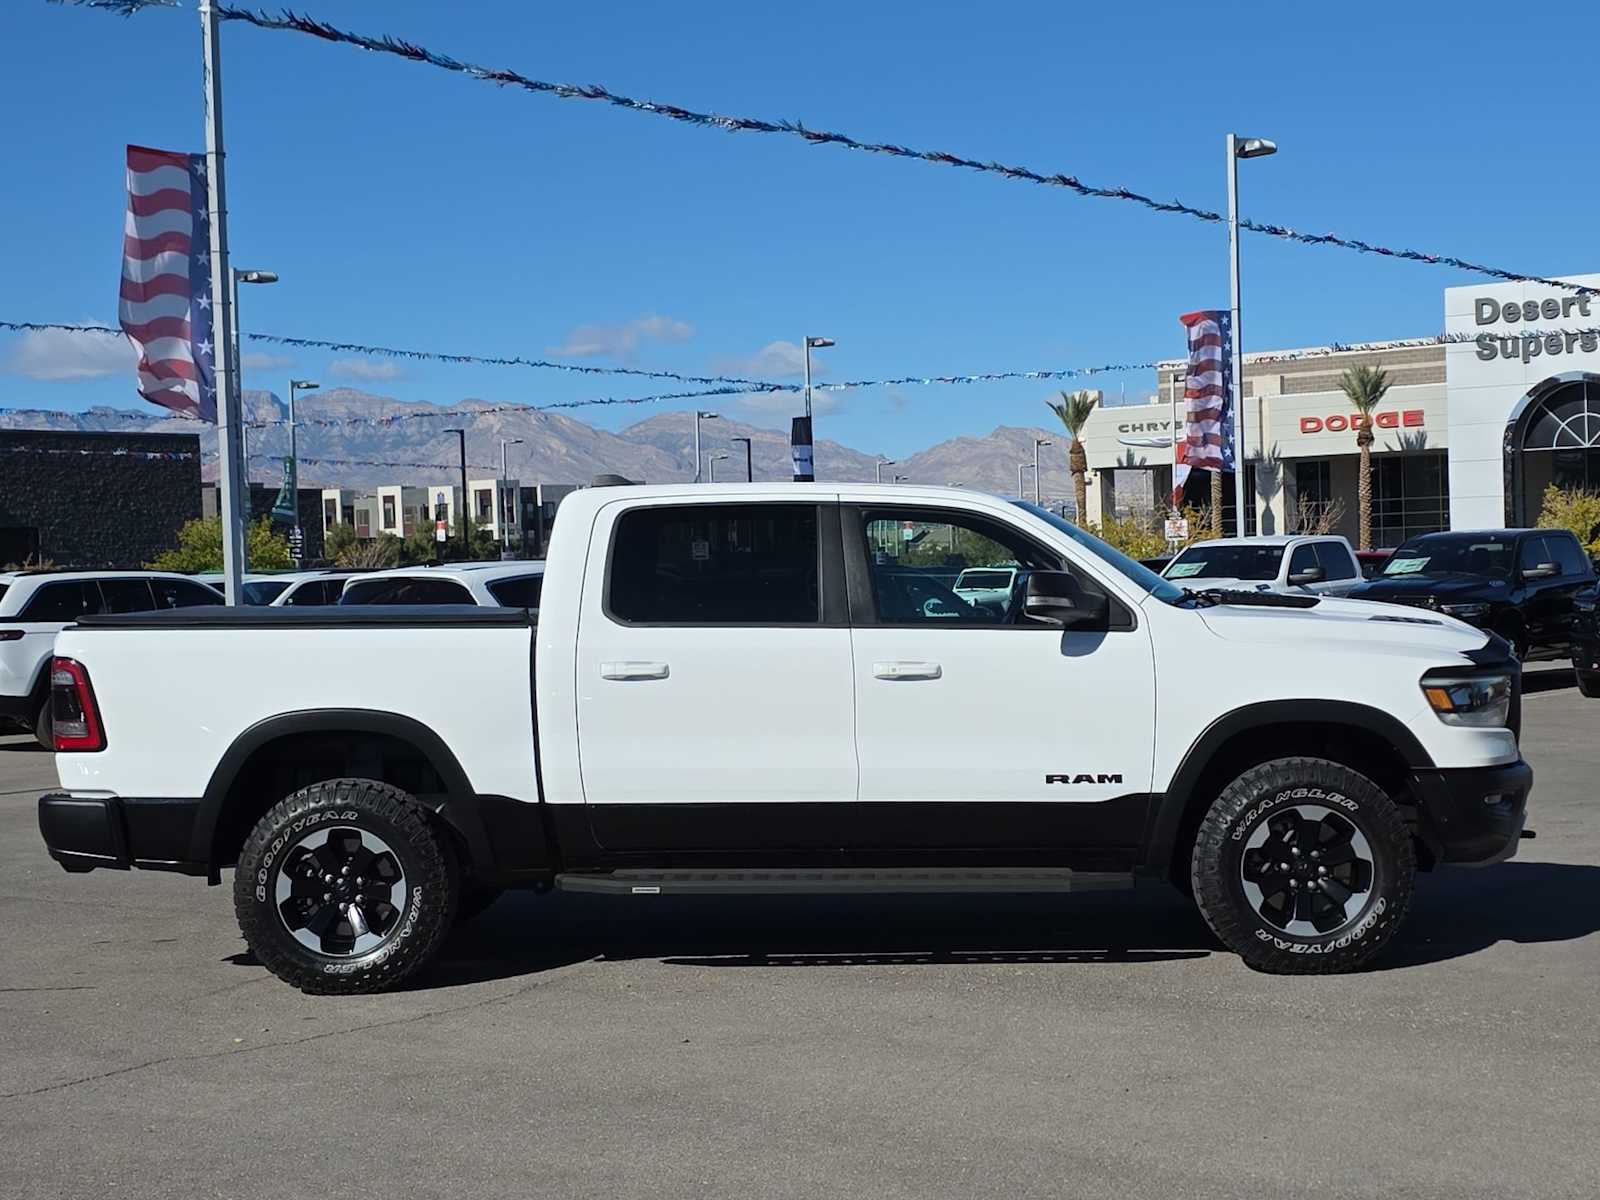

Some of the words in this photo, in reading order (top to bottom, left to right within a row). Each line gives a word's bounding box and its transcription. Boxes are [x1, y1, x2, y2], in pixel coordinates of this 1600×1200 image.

[1475, 296, 1591, 325] Desert
[1476, 332, 1598, 364] Supers
[1045, 774, 1123, 784] RAM
[1231, 788, 1359, 841] WRANGLER
[255, 810, 358, 902] GOODYEAR
